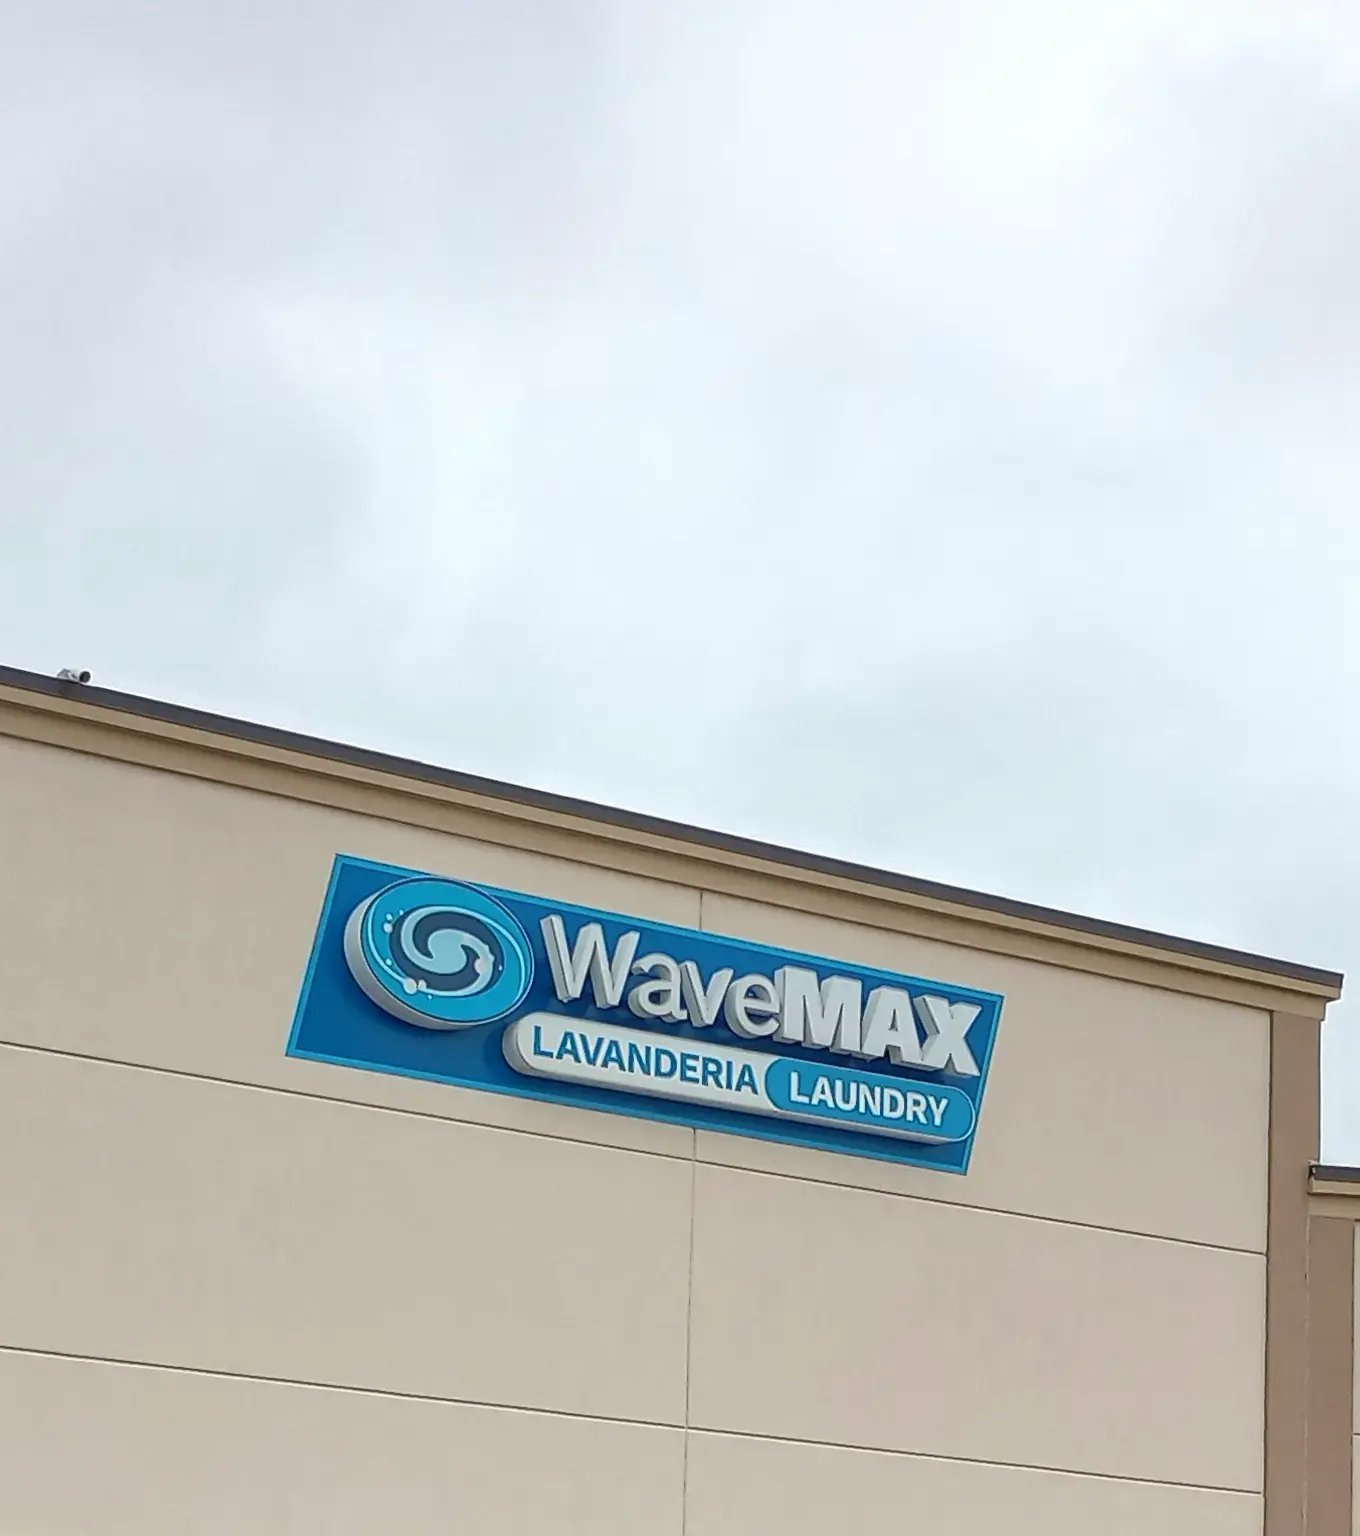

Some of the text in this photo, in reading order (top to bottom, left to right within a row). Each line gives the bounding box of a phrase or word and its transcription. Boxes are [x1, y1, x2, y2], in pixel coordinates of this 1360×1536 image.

[540, 914, 981, 1077] WaveMAX
[532, 1025, 949, 1127] LAVANDERIA LAUNDRY
